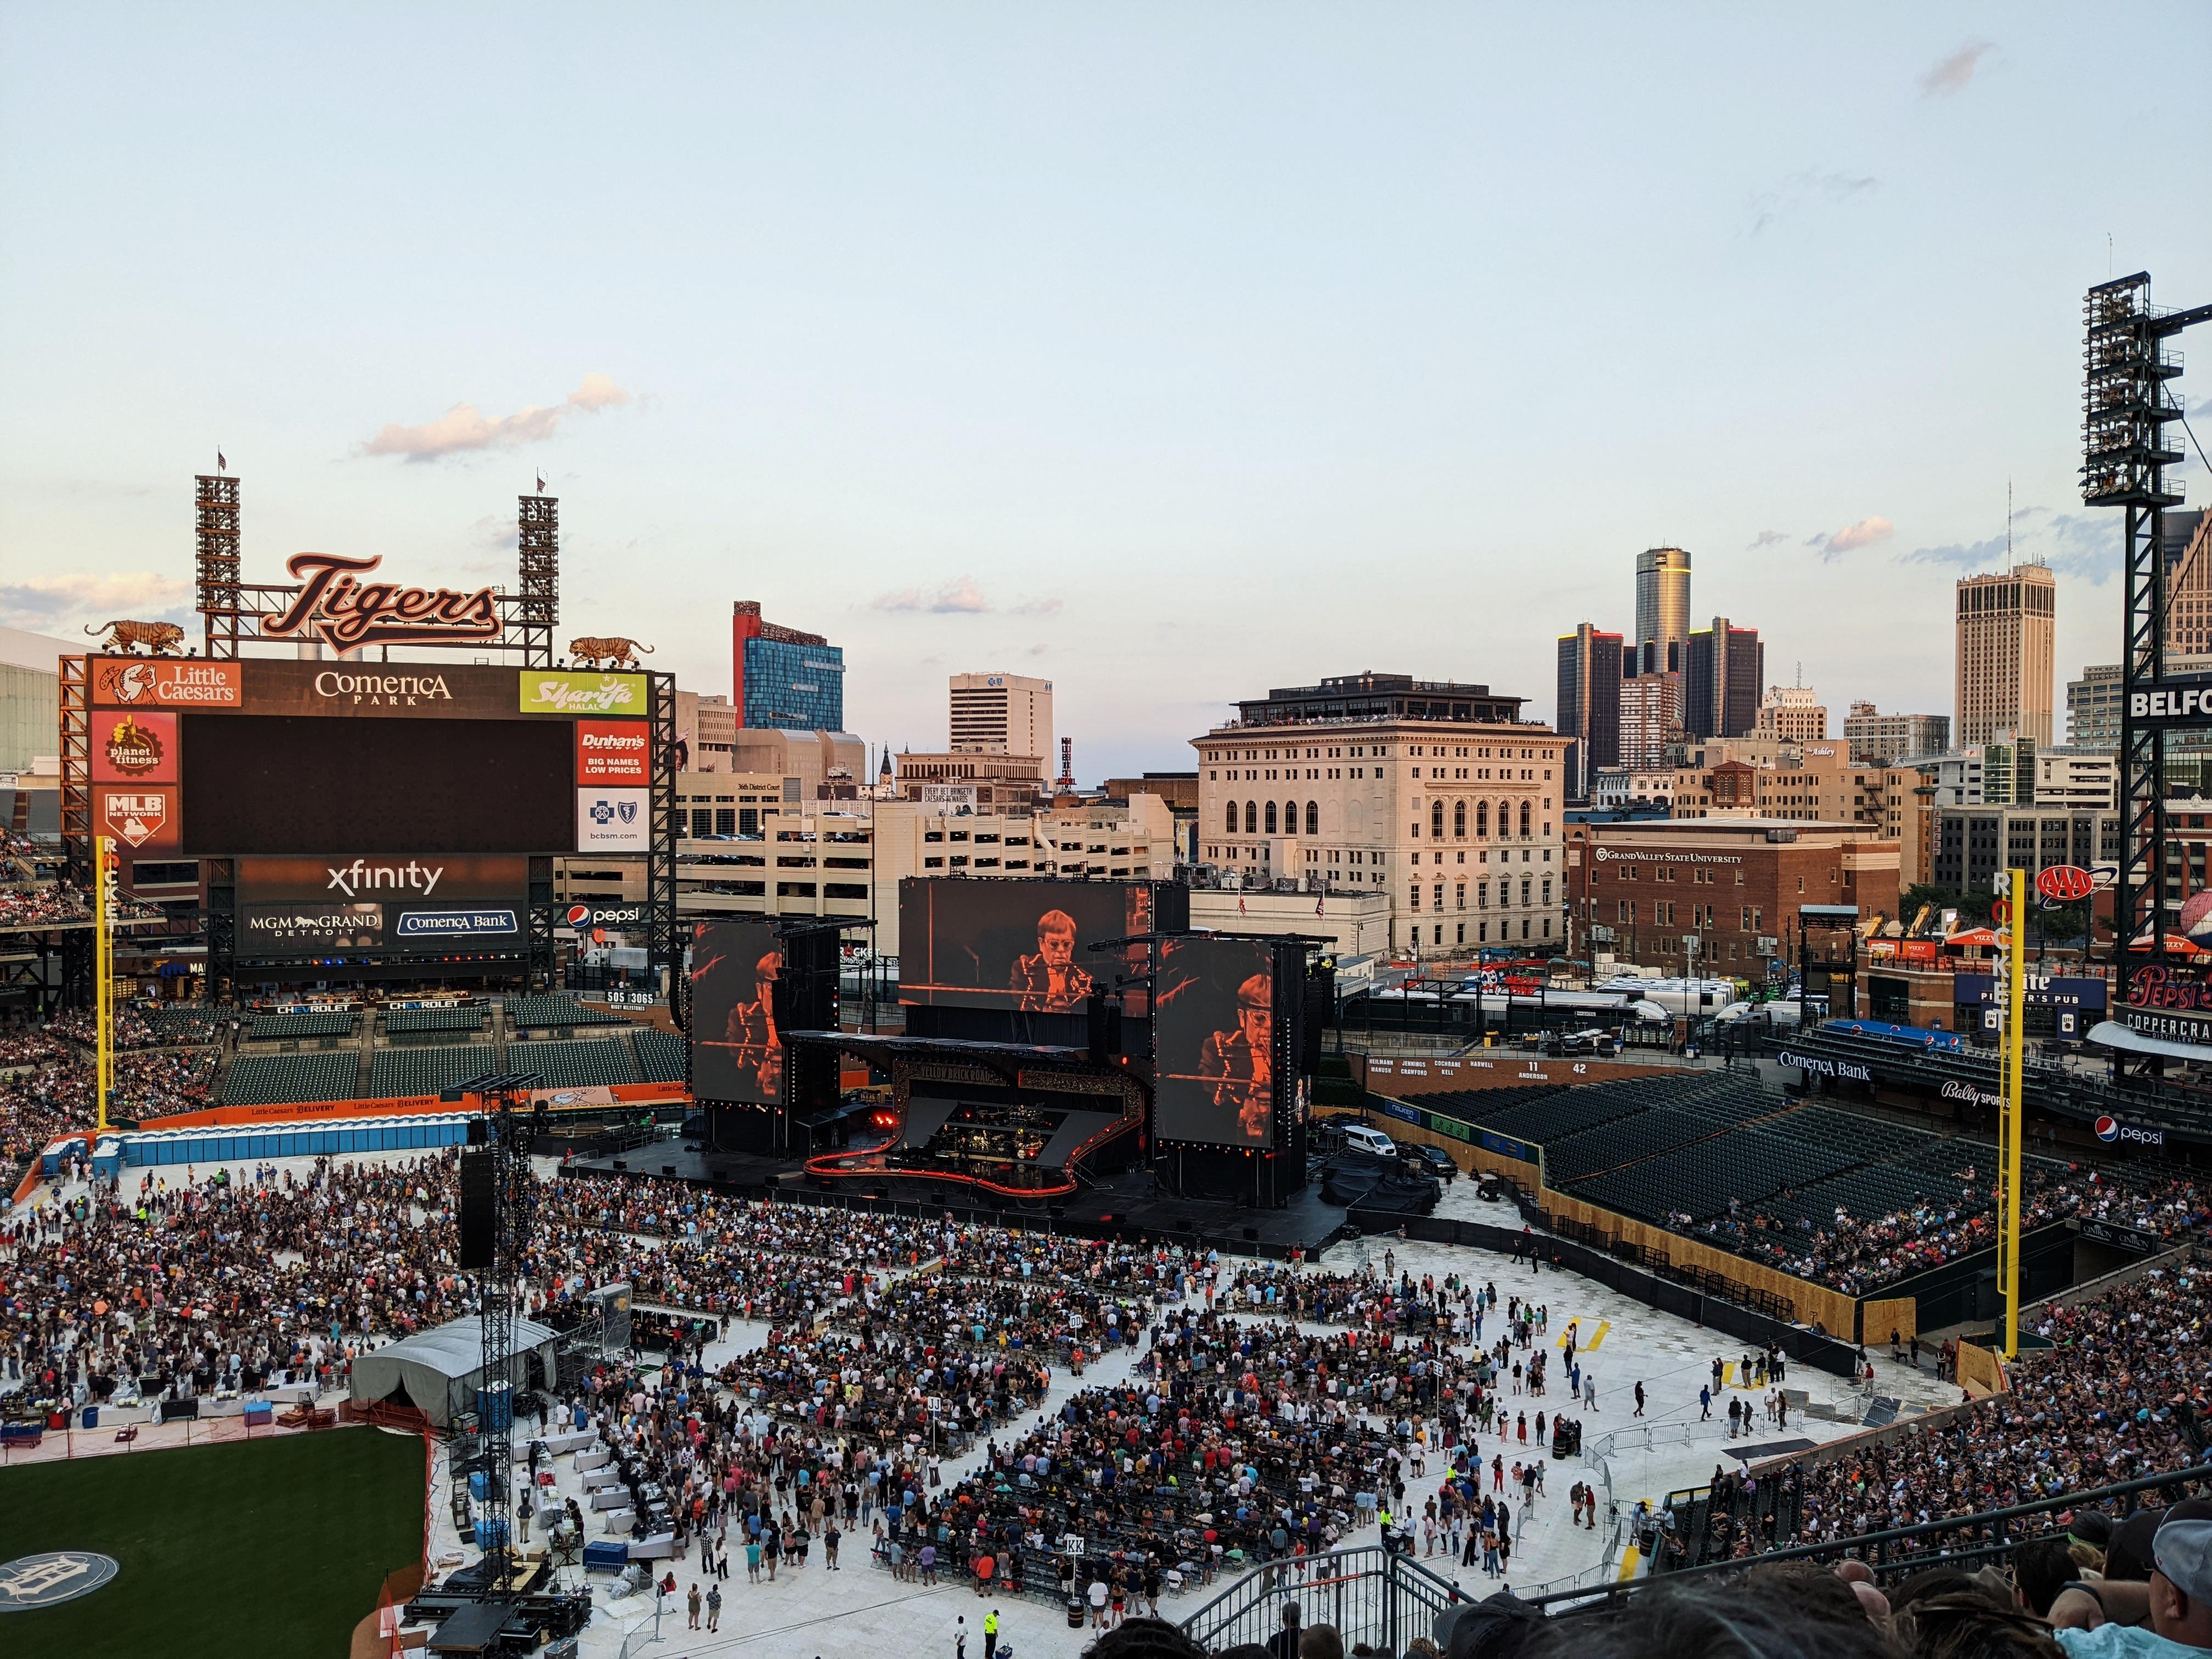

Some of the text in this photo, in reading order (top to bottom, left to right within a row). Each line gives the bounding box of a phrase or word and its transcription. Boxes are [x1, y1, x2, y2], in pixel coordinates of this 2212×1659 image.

[261, 552, 503, 656] Tigers
[174, 665, 226, 685] Little
[159, 681, 235, 701] Caesars
[531, 677, 633, 709] Sharifa
[354, 695, 417, 706] PARK
[582, 734, 645, 747] Dunham's
[110, 747, 150, 758] planet
[1810, 747, 1835, 758] Ashley
[116, 755, 159, 764] fitness
[109, 797, 162, 811] MLB
[590, 832, 638, 840] bcbsm.com
[1607, 850, 1742, 864] GRAND VALLEY STATE UNIVERSITY
[328, 859, 444, 896] xfinity
[2040, 867, 2091, 899] AAA
[103, 838, 120, 933] ROCKET
[250, 915, 379, 929] MGM GRAND
[473, 915, 508, 927] Bank
[593, 907, 639, 924] pepsi
[1992, 872, 2012, 1032] ROCKET
[2023, 974, 2050, 992] ite
[2126, 965, 2197, 1009] PEPSI
[607, 992, 653, 1004] 505 3065
[2055, 996, 2079, 1004] PUB
[277, 1004, 350, 1014] CHEVROLET
[390, 1000, 460, 1010] CHEVROLET
[2128, 1014, 2210, 1039] COPPERCRA
[2152, 1032, 2197, 1043] DISTILLERY
[922, 1065, 947, 1079] YELLOW
[949, 1069, 970, 1081] BRICK
[1528, 1062, 1538, 1071] 11
[1573, 1063, 1587, 1074] 42
[1838, 1062, 1871, 1081] Bank
[1519, 1072, 1548, 1080] ANDERSON
[1941, 1081, 1980, 1107] Bally
[397, 1098, 434, 1108] DELIVERY
[251, 1108, 268, 1116] Little
[296, 1104, 335, 1114] DELIVERY
[1391, 1104, 1414, 1116] FALKEN
[2121, 1127, 2163, 1144] pepsi
[2084, 1224, 2112, 1239] CINTRON
[2119, 1234, 2149, 1248] CINTRON
[1070, 1317, 1081, 1327] DD
[1434, 1364, 1442, 1374] EE
[928, 1398, 940, 1410] JJ
[1068, 1540, 1083, 1553] KK
